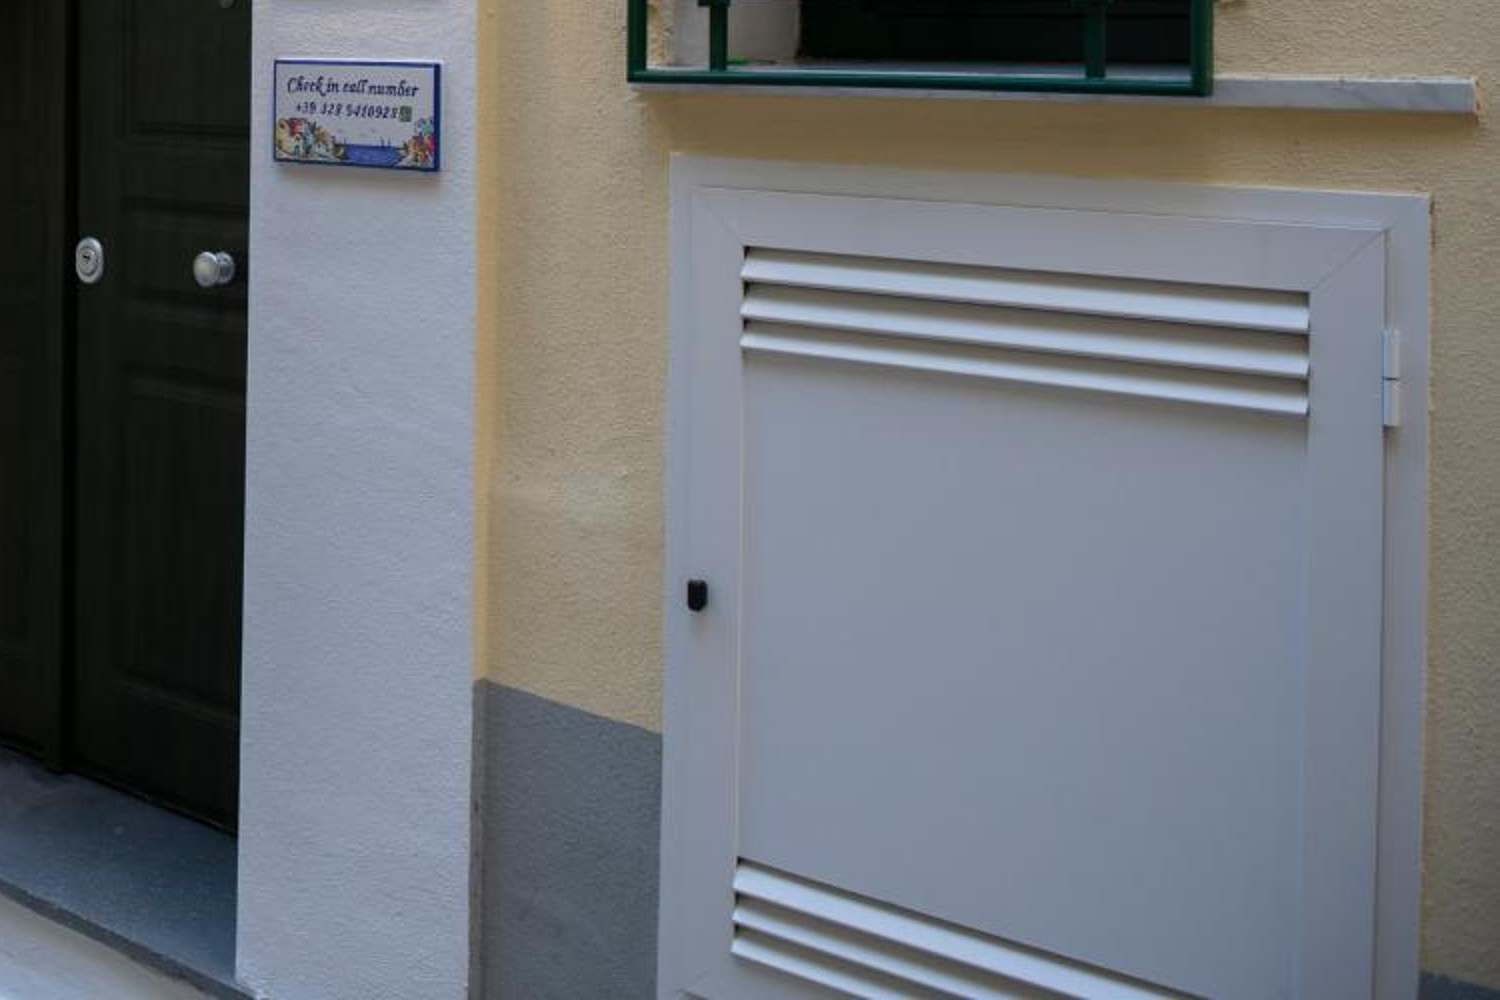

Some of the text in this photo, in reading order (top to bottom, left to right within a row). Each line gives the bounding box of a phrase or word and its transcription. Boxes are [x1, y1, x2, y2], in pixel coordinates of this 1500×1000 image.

[287, 76, 420, 97] Check in call number
[296, 102, 316, 114] +39
